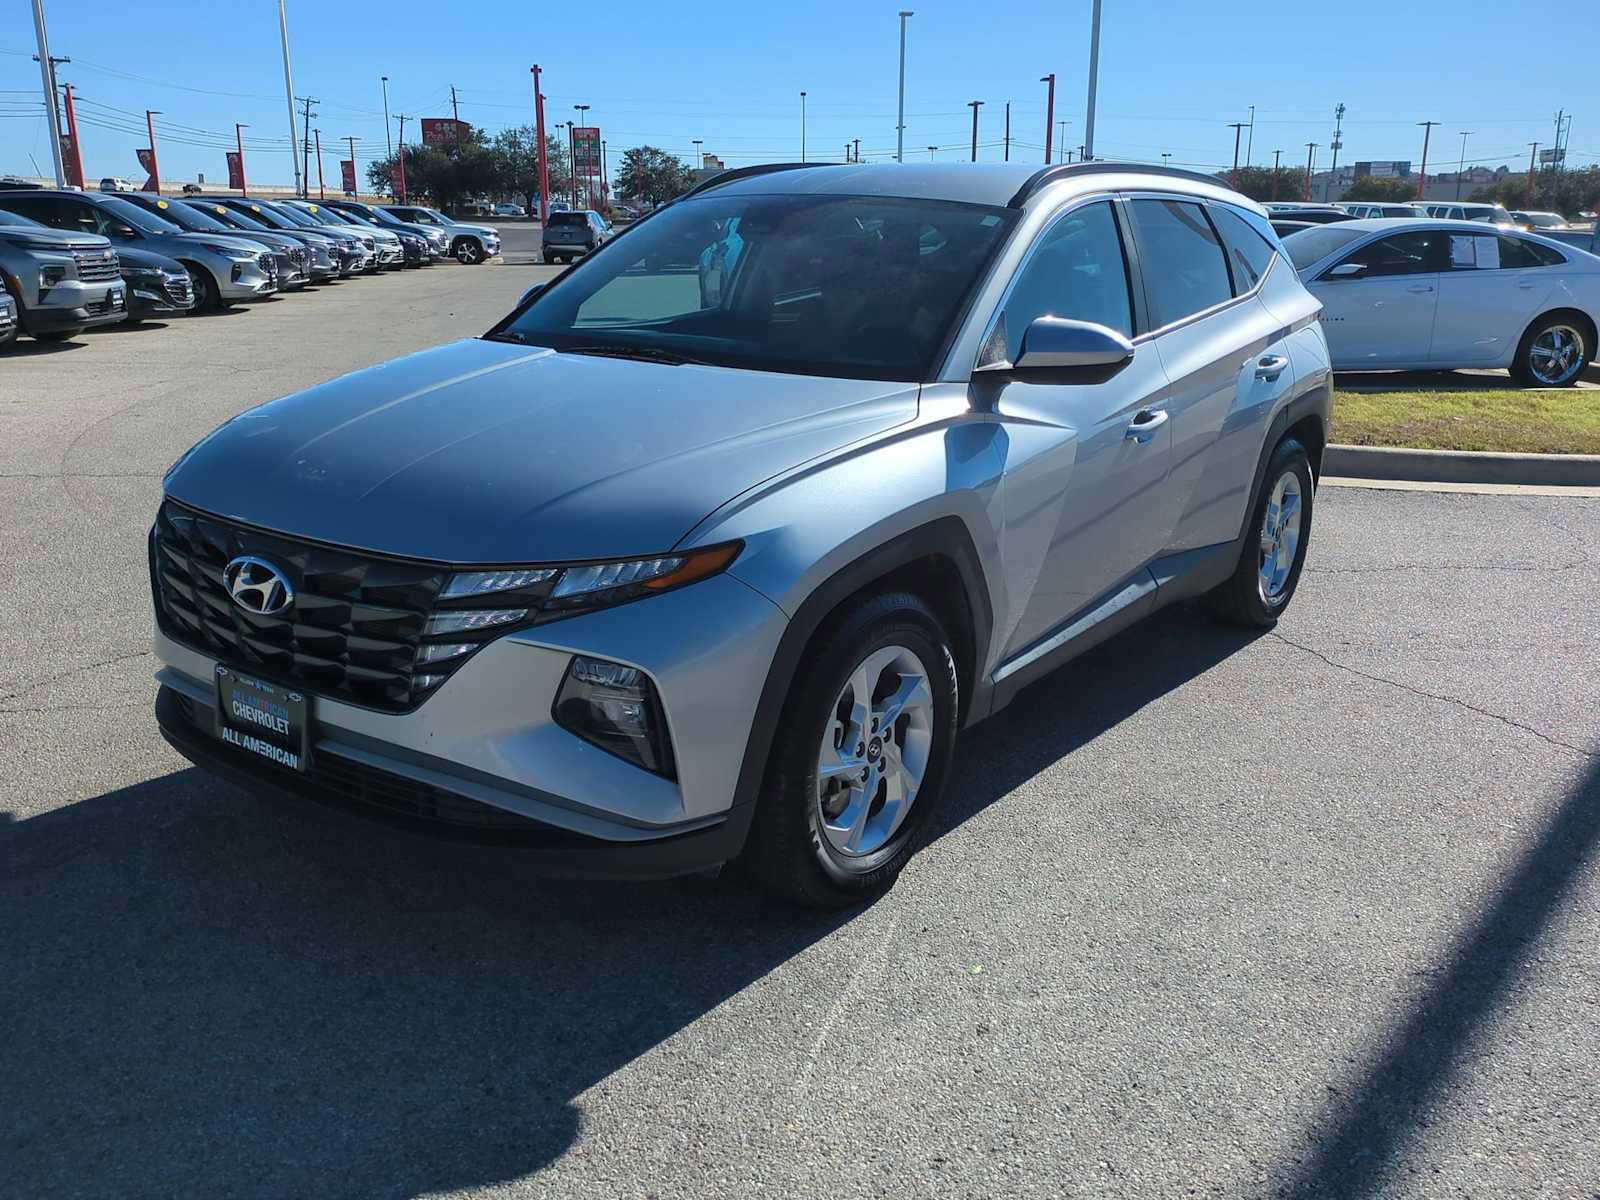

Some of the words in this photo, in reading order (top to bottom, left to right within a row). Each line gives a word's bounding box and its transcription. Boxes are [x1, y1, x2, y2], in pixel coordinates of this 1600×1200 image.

[232, 700, 289, 735] CHEVROLET
[222, 726, 241, 745] ALL
[242, 735, 298, 769] AMERICAN
